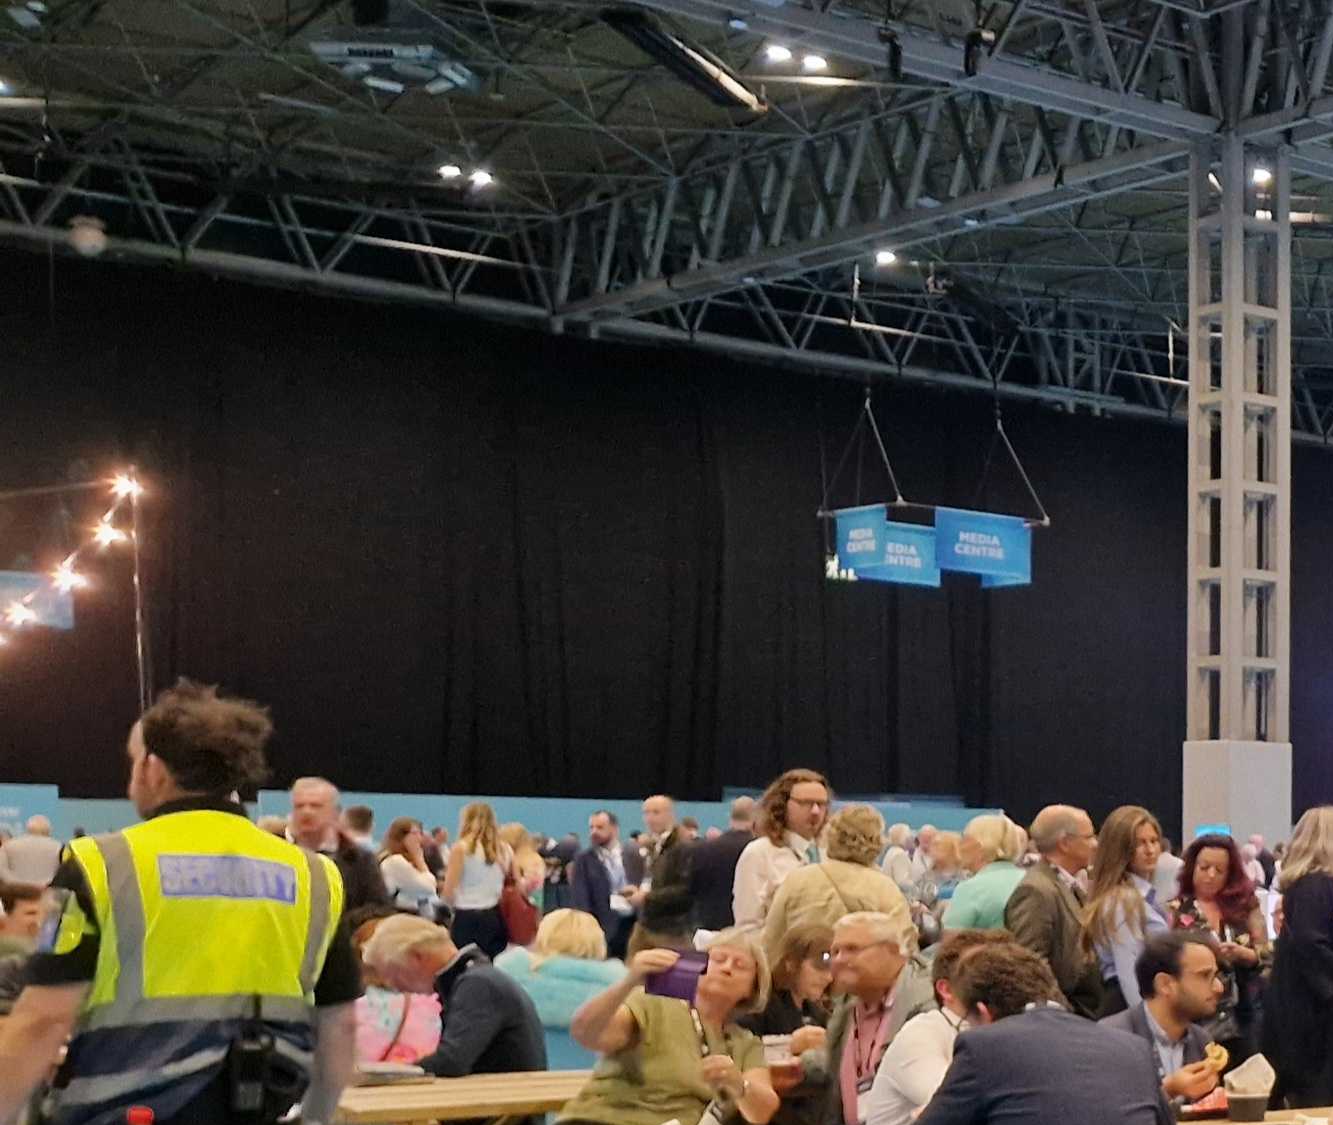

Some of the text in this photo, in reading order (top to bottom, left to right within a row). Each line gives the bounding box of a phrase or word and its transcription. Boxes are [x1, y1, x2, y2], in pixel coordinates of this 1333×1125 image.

[849, 528, 874, 541] MEDIA
[958, 530, 1001, 546] MEDIA
[846, 539, 876, 553] CENTRE
[887, 541, 918, 556] EDIA
[954, 543, 1005, 560] CENTRE
